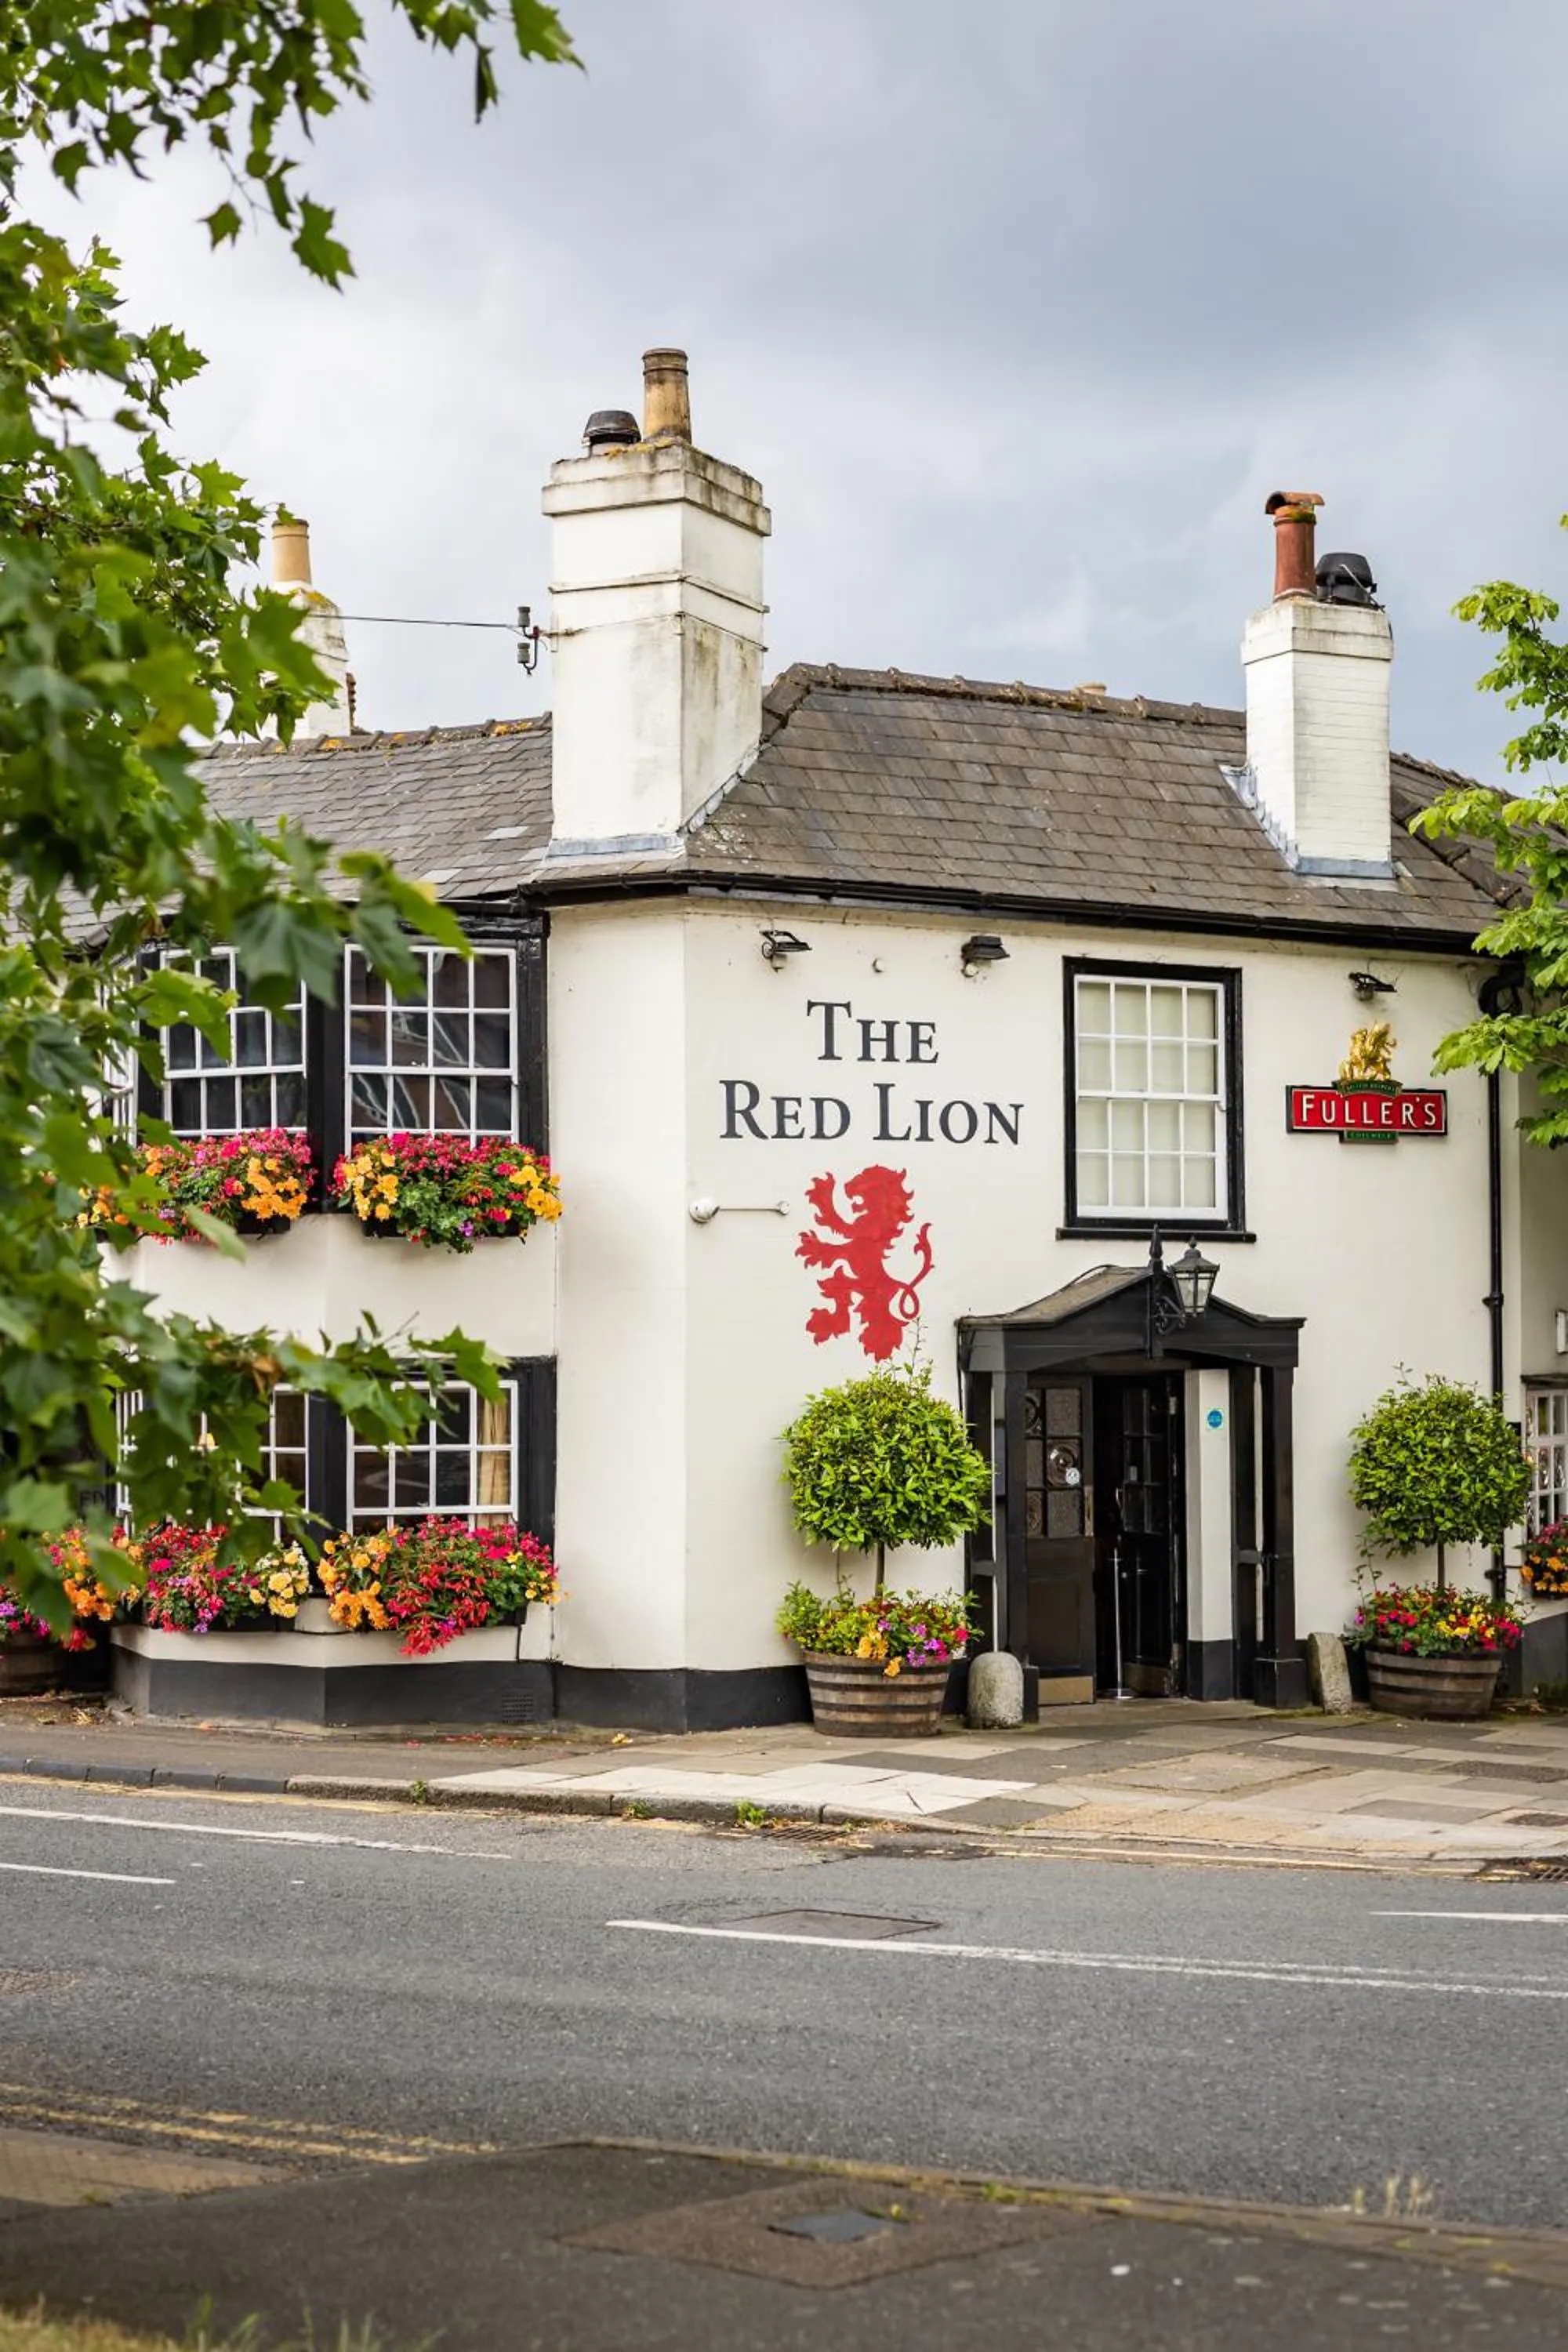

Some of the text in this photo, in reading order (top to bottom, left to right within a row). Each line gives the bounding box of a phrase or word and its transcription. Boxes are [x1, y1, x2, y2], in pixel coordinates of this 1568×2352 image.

[808, 1000, 939, 1063] THE
[719, 1080, 1024, 1145] RED LION
[1301, 1094, 1436, 1127] FULLER'S
